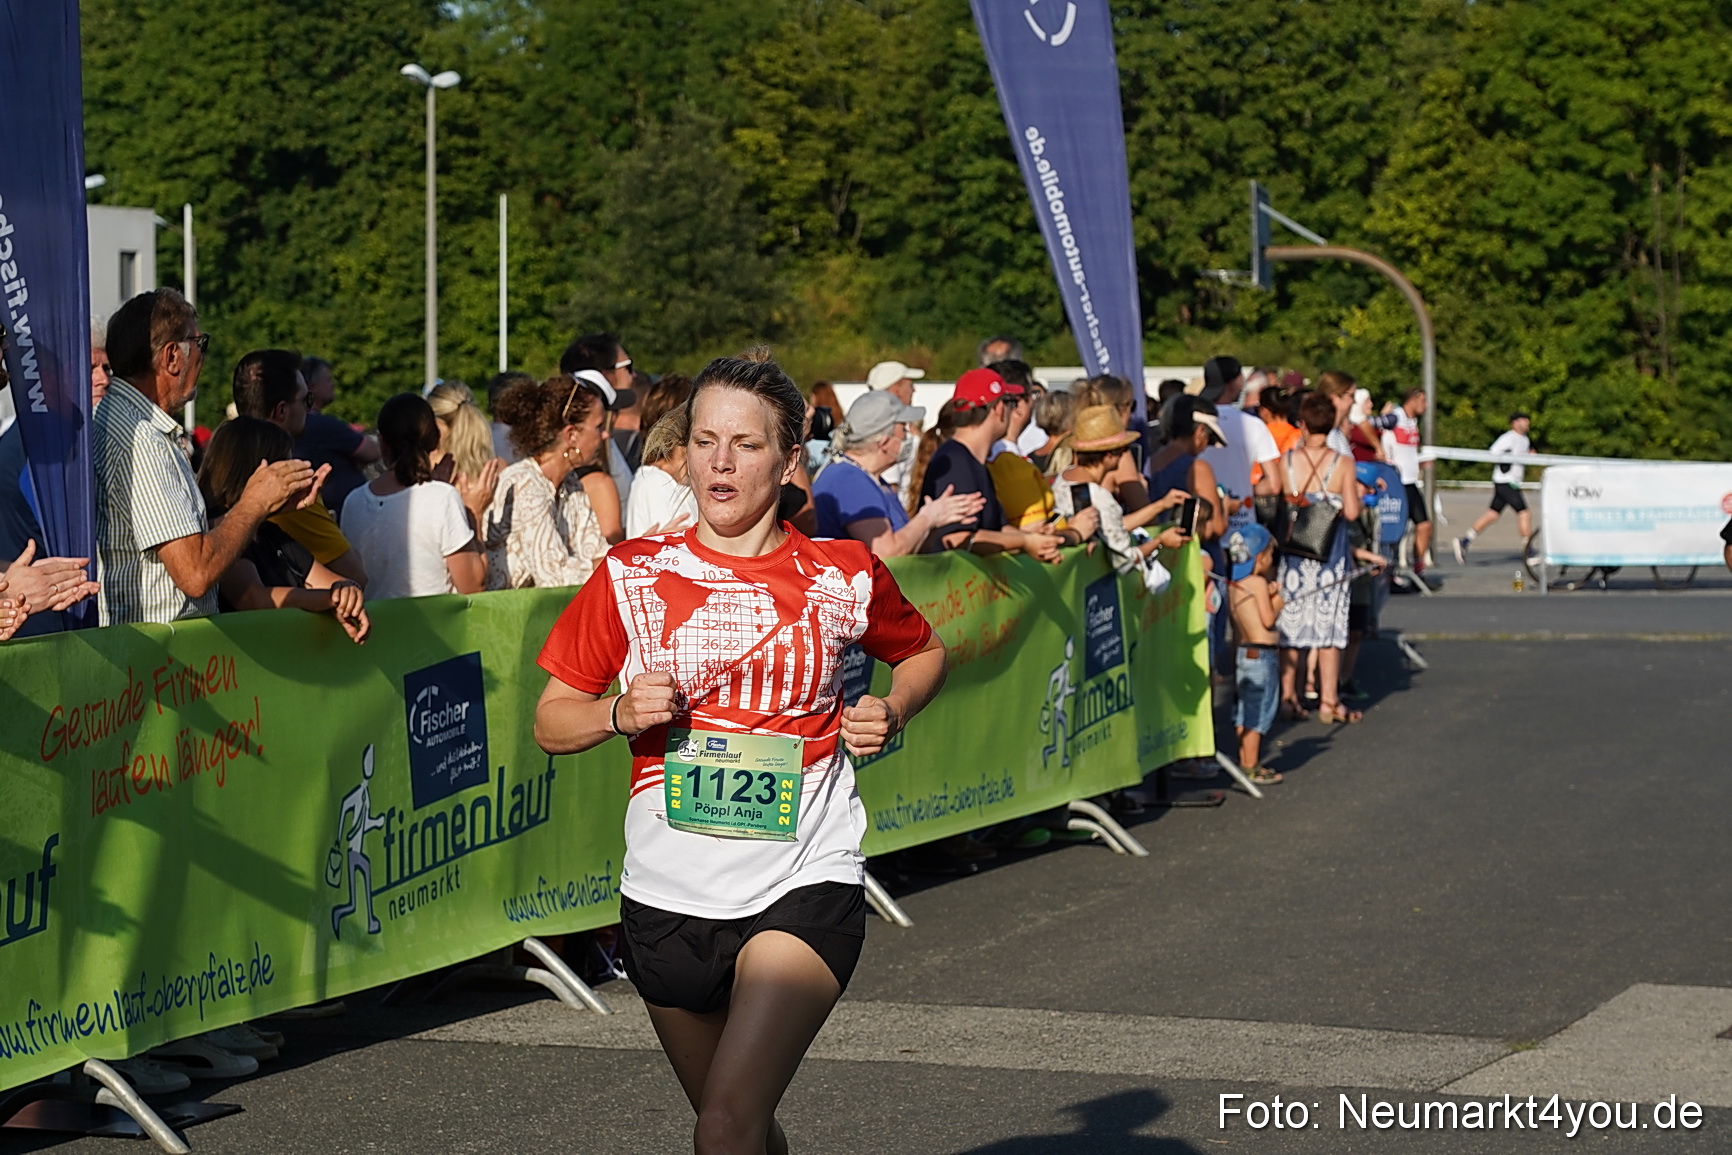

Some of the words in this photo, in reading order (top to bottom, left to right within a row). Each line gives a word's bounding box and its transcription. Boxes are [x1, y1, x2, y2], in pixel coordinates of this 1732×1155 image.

[41, 666, 146, 762] Gesunde
[152, 655, 239, 716] Firmen
[420, 701, 470, 736] Fischer
[91, 741, 173, 818] laufen
[176, 695, 264, 788] länger!
[425, 723, 467, 748] AUTOMOBILE
[699, 750, 742, 759] Firmenlauf
[671, 774, 683, 810] RUN
[686, 765, 777, 805] 1123
[778, 779, 794, 826] 2022
[384, 755, 556, 887] firmenlauf
[694, 802, 731, 818] Pöppl
[733, 805, 763, 820] Anja
[0, 832, 60, 941] uf
[388, 864, 462, 921] neumarkt
